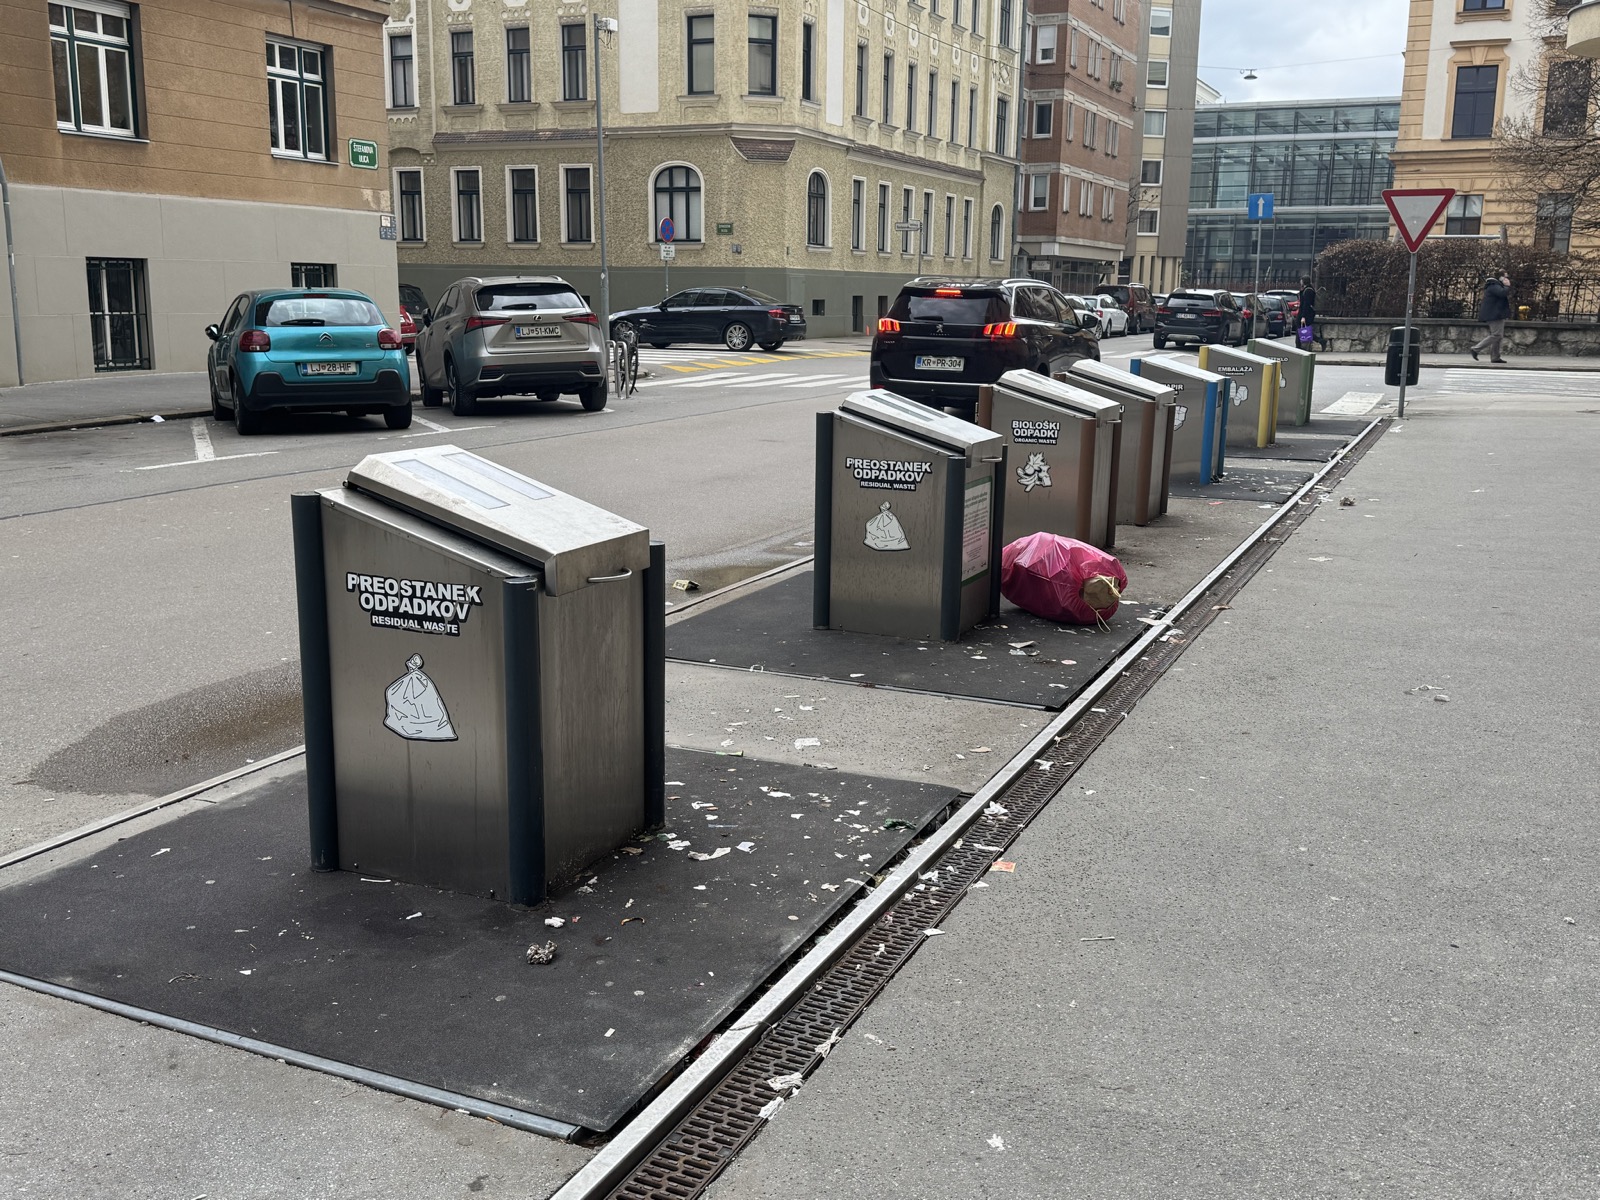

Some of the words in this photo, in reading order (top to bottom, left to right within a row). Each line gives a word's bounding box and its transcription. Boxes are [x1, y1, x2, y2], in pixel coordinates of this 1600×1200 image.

[521, 327, 531, 336] LJ
[535, 326, 559, 335] 51-KMC
[310, 363, 321, 372] LJ
[921, 358, 931, 367] KR
[936, 359, 961, 368] PR-304
[1012, 420, 1060, 430] BIOLOŠKI
[1013, 428, 1058, 438] ODPADKI
[846, 457, 932, 472] PREOSTANEK
[854, 468, 924, 482] ODPADKOV
[860, 481, 892, 489] RESIDUAL
[347, 573, 481, 603] PREOSTANEK
[360, 592, 469, 620] ODPADKOV
[372, 615, 421, 629] RESIDUAL
[422, 620, 459, 634] WASTE
